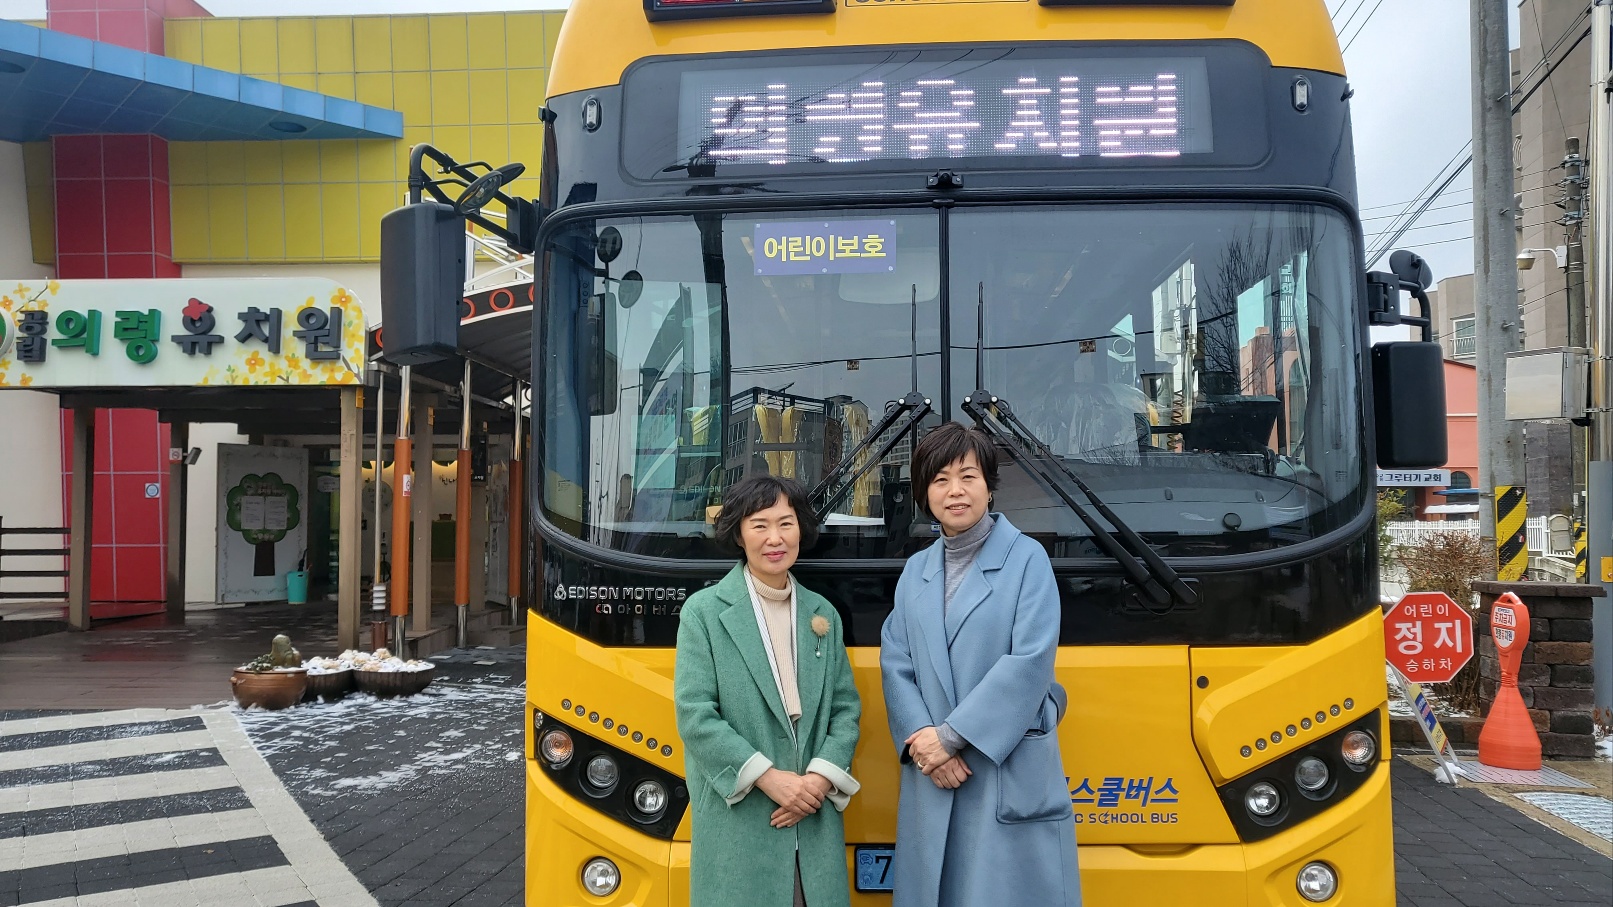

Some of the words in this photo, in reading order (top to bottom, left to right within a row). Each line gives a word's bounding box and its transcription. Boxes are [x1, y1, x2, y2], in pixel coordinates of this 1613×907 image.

[763, 234, 887, 262] 어린이보호
[16, 310, 48, 362] 공립
[1385, 473, 1422, 483] 그루터기
[1423, 473, 1442, 483] 교회
[568, 586, 619, 600] EDISON
[621, 586, 687, 601] MOTORS
[1404, 603, 1449, 618] 어린이
[1393, 619, 1463, 656] 정지
[1405, 657, 1453, 673] 승하차
[1088, 811, 1147, 824] SCHOOL
[1150, 812, 1179, 824] BUS
[875, 855, 893, 884] 7
